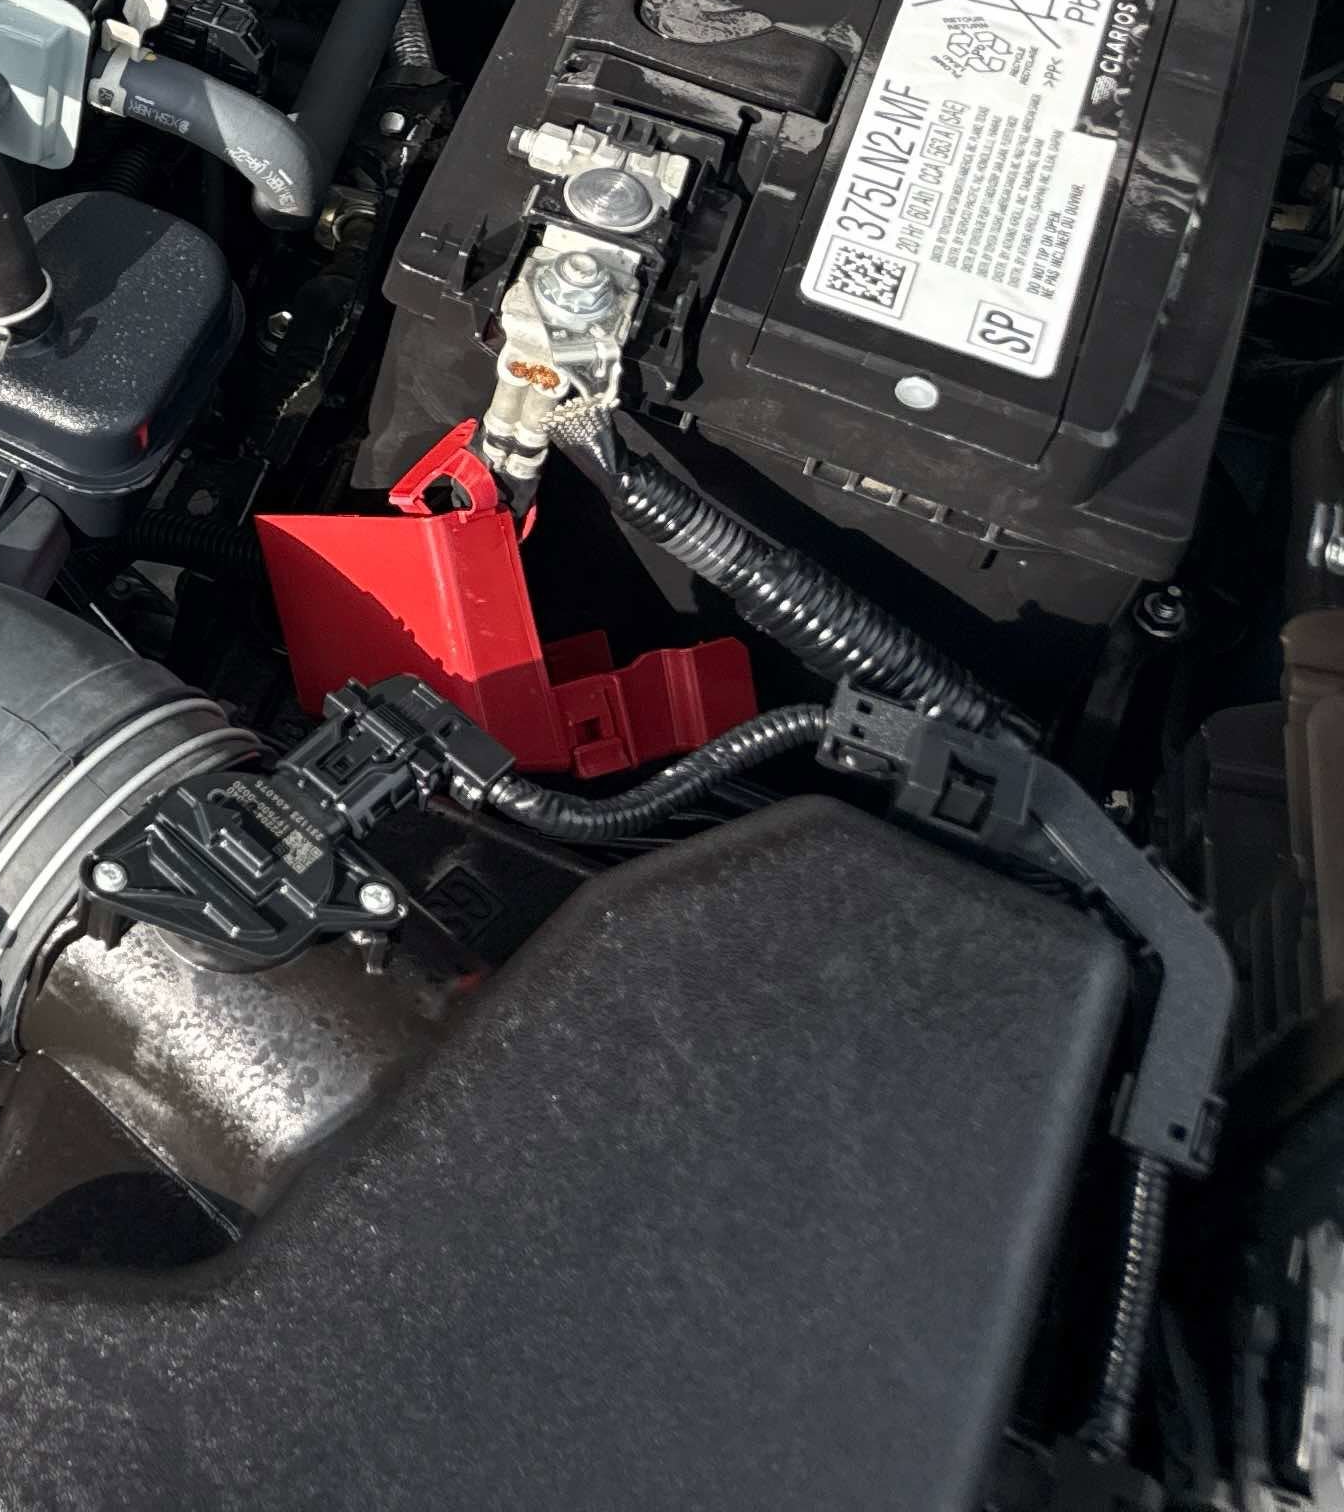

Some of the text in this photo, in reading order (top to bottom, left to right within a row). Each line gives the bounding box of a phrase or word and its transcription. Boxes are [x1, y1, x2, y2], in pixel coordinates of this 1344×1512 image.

[1097, 0, 1139, 76] CLARIOS
[832, 78, 934, 243] 375LN2-MF
[893, 96, 972, 255] 20 Hr 60 Ah CCA 563 A (SAE)
[1039, 232, 1054, 247] OR
[1034, 246, 1051, 262] TIP
[1029, 261, 1046, 281] NOT
[1043, 267, 1060, 287] PAS
[1025, 279, 1041, 295] DO
[1039, 285, 1055, 300] NE
[975, 305, 1039, 357] SP
